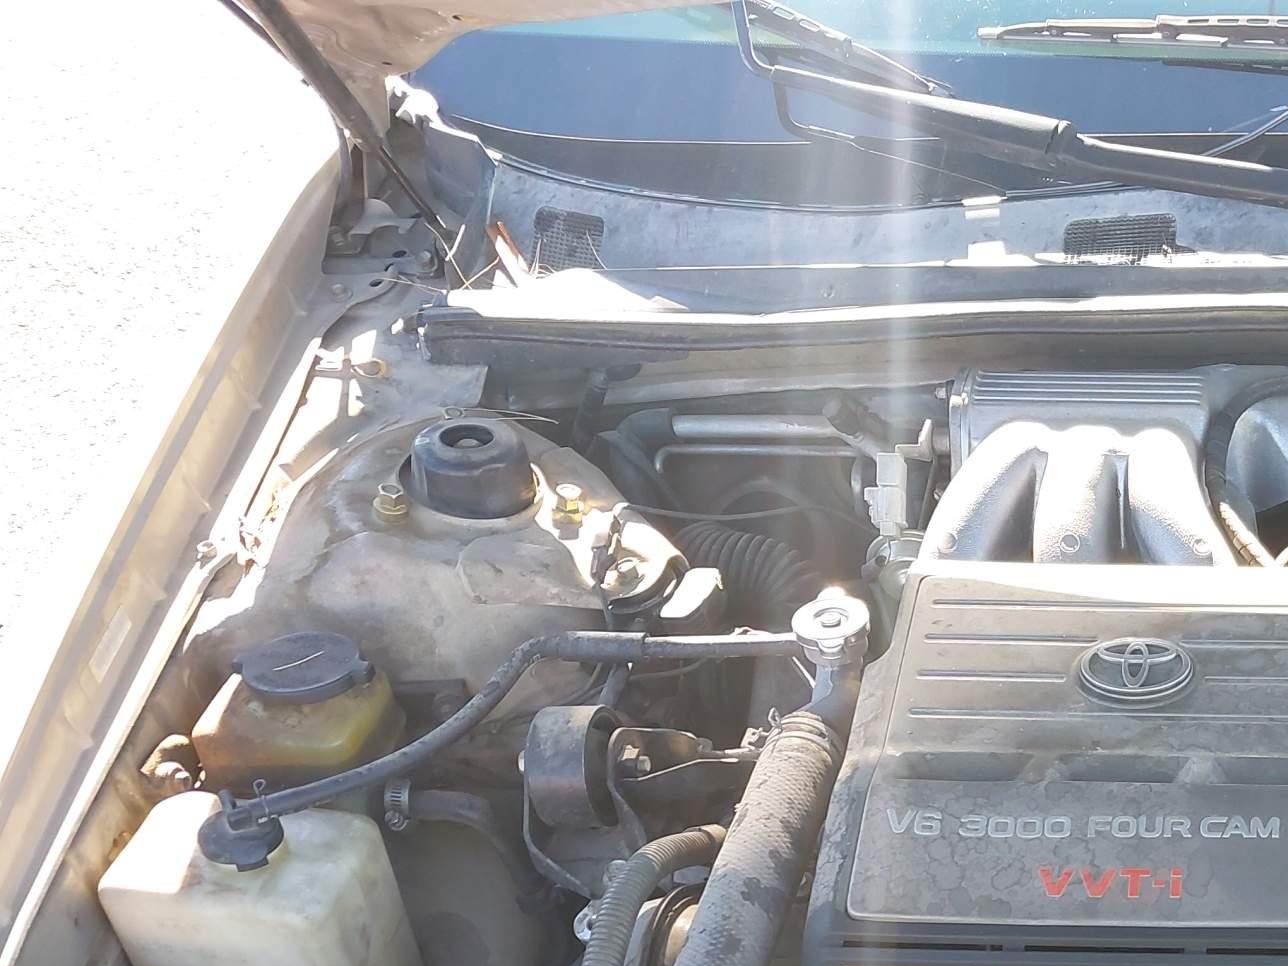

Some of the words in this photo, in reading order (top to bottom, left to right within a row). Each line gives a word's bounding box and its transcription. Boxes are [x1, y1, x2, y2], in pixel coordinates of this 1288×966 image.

[887, 808, 943, 836] V6
[958, 814, 1072, 839] 3000
[1087, 815, 1192, 838] FOUR
[1200, 815, 1280, 839] CAM
[1038, 866, 1184, 898] VVT-i
